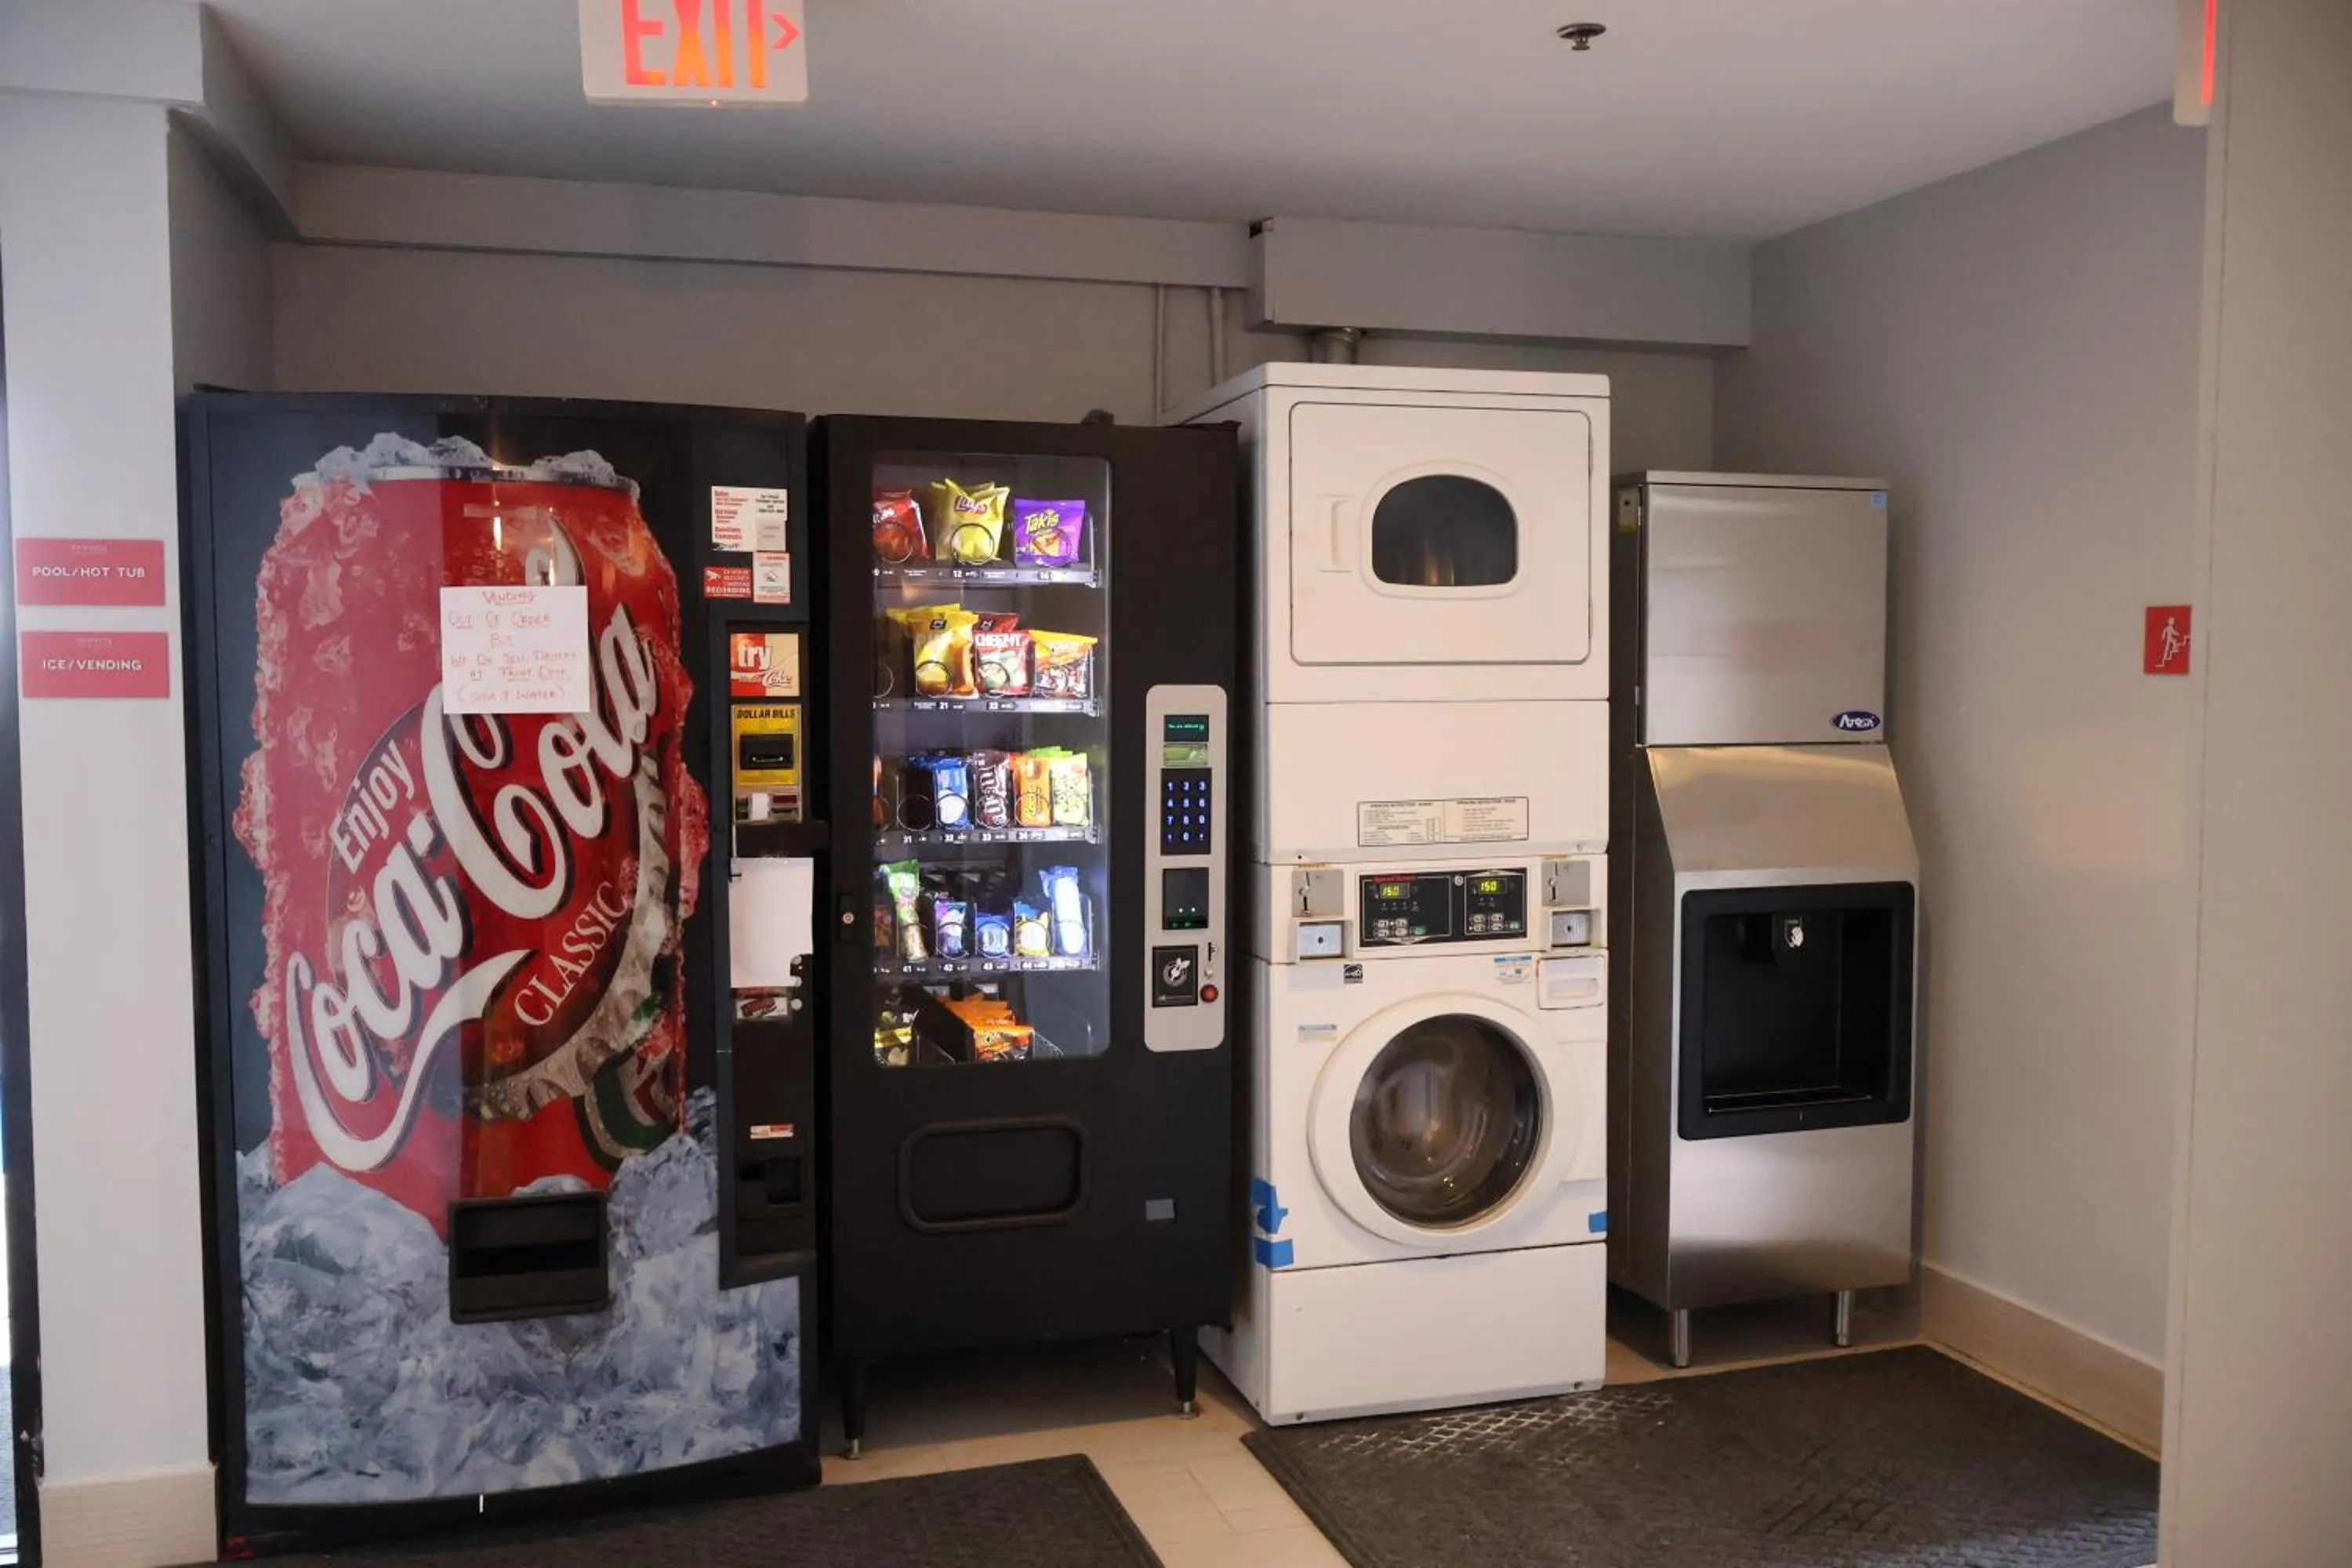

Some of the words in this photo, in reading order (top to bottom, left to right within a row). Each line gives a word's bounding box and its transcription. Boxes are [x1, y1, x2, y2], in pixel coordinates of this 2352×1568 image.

[622, 0, 768, 88] EXIT
[1025, 513, 1060, 534] Takis
[32, 566, 110, 578] POOL/HOT
[118, 567, 146, 579] TUB
[42, 659, 142, 671] ICE/VENDING
[739, 645, 771, 670] try
[737, 709, 770, 719] DOLLAR
[772, 708, 795, 718] BILLS
[329, 739, 416, 877] Enjoy
[513, 880, 630, 1027] CLASSIC
